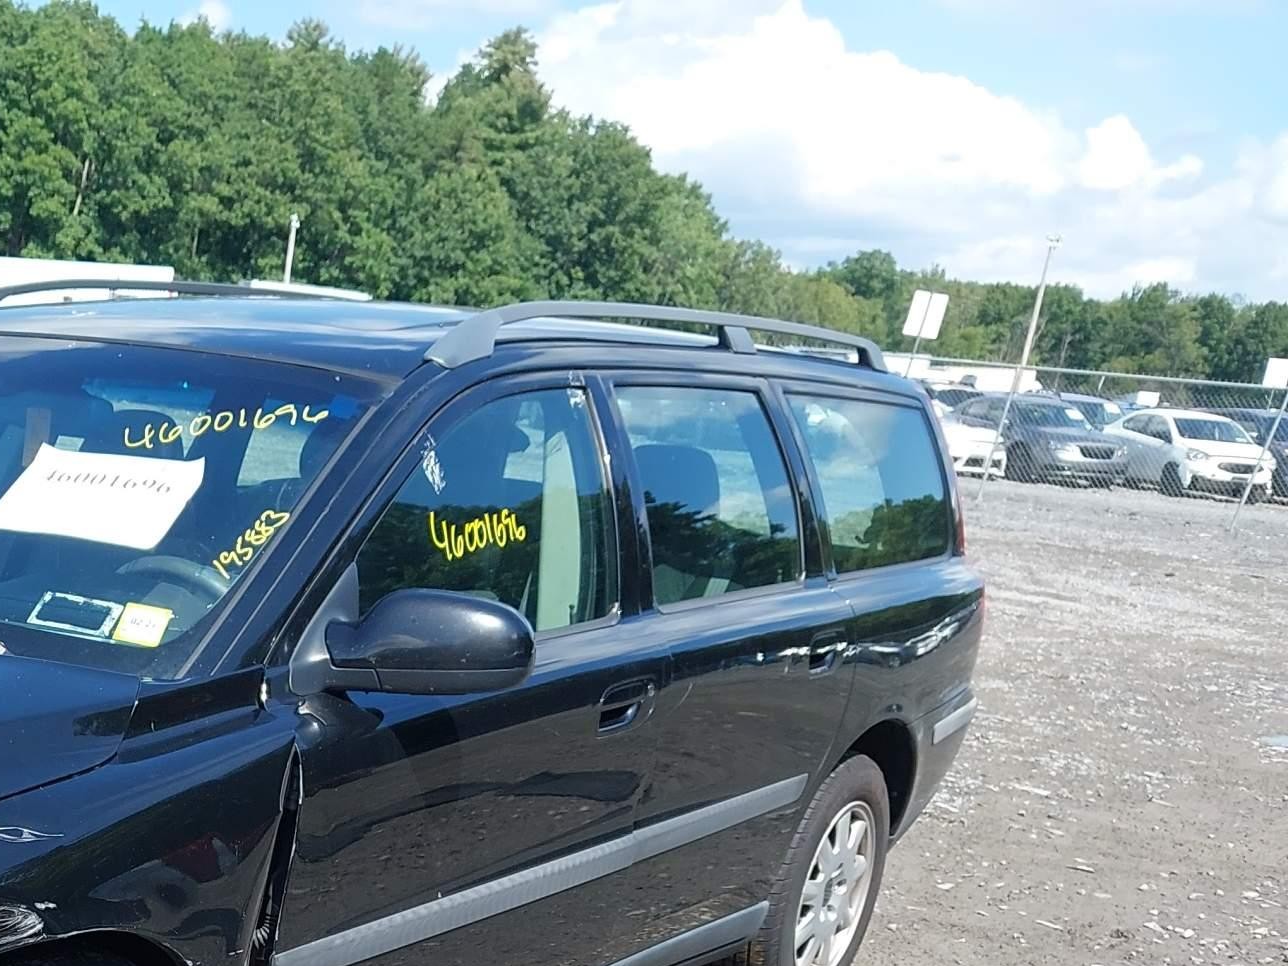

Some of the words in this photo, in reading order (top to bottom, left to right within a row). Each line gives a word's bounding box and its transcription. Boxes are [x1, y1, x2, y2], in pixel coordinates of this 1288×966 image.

[124, 404, 329, 449] 46001696
[212, 509, 291, 580] 195883
[429, 508, 527, 561] 46001696
